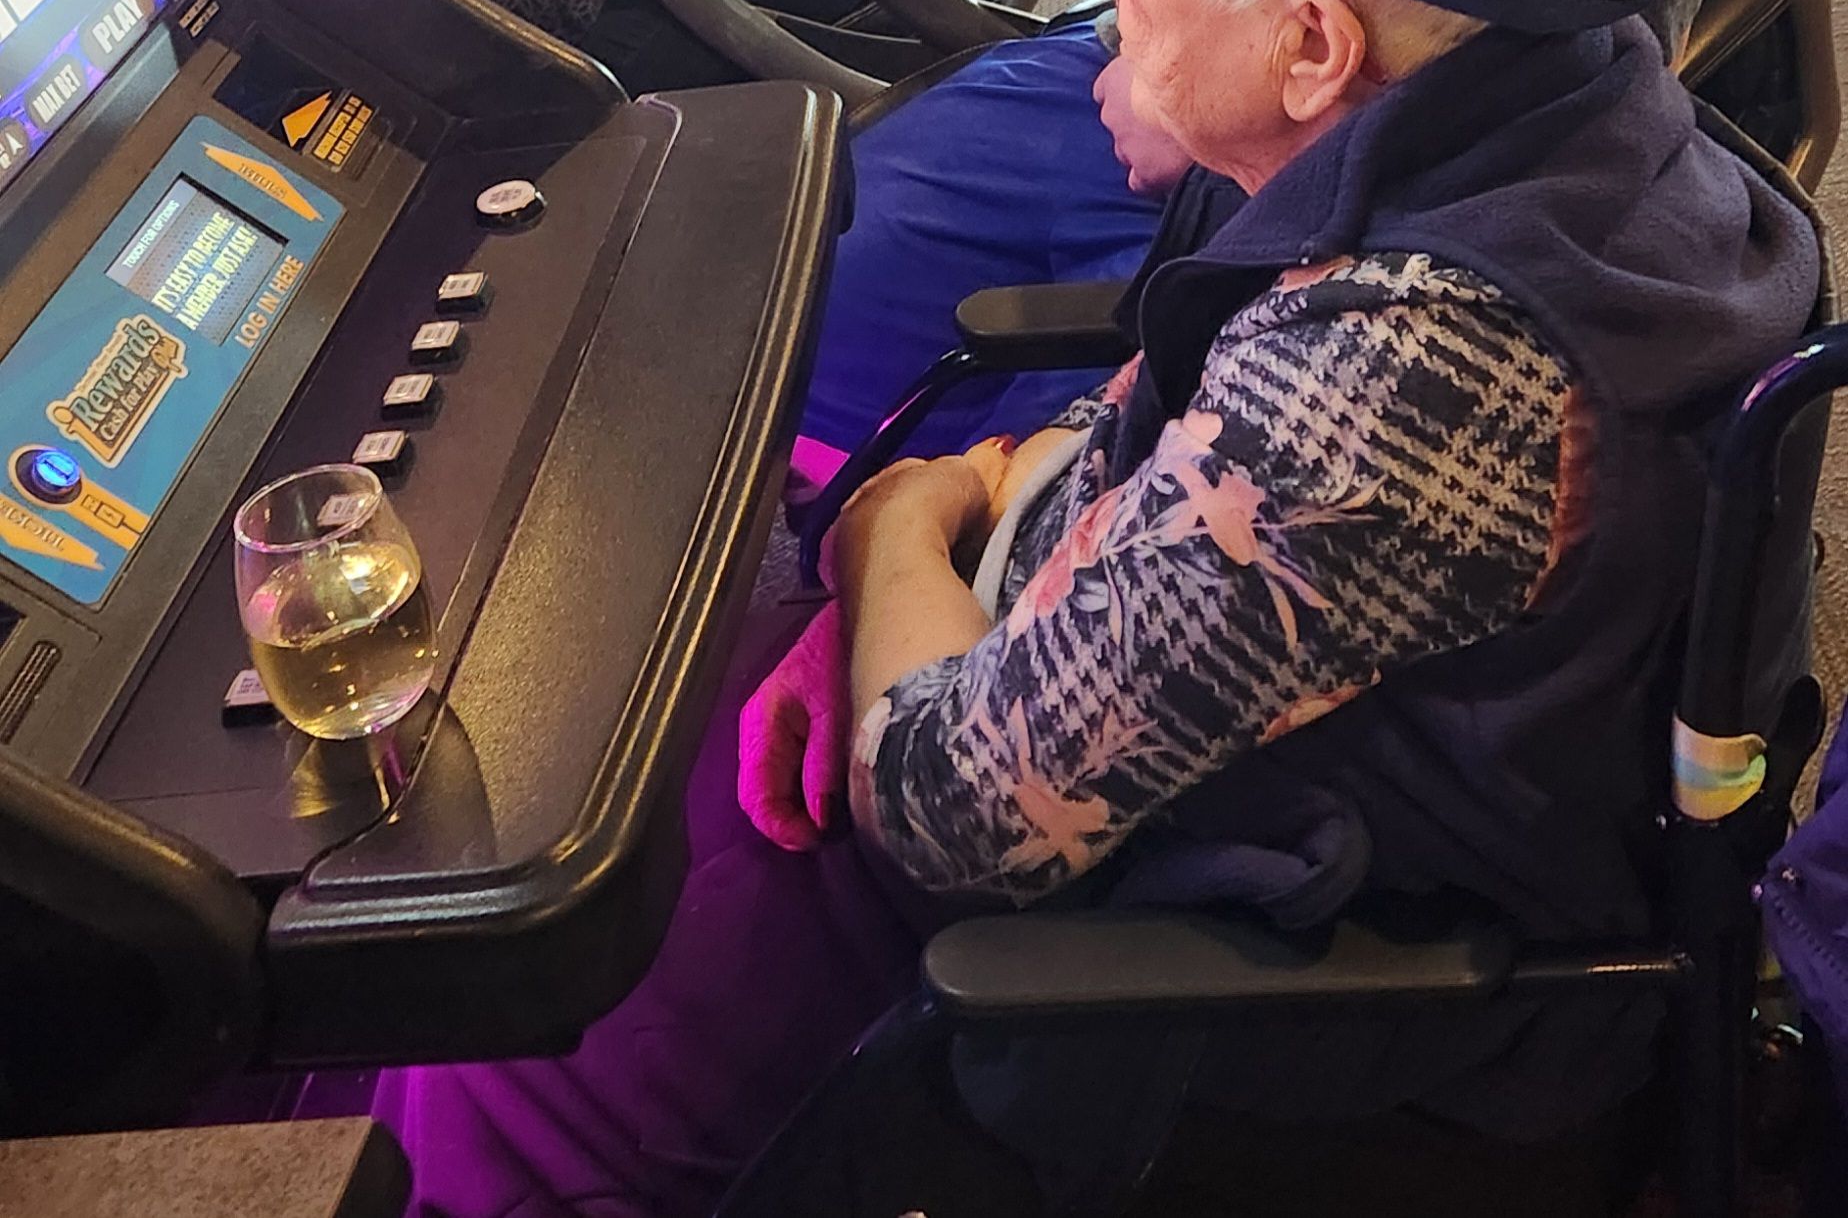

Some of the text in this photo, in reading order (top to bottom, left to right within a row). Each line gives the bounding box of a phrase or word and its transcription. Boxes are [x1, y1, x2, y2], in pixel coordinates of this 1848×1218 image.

[32, 63, 80, 123] MAX BET
[122, 199, 180, 269] TOUCH FOR OPTIONS
[192, 212, 235, 256] BECOME
[227, 225, 258, 256] ASK!
[165, 262, 198, 294] EASY
[182, 249, 206, 269] TO
[212, 246, 243, 279] JUST
[234, 254, 305, 349] LOG IN HERE
[176, 313, 199, 331] A
[99, 407, 130, 441] Cash
[119, 387, 142, 412] for
[133, 365, 160, 392] Play
